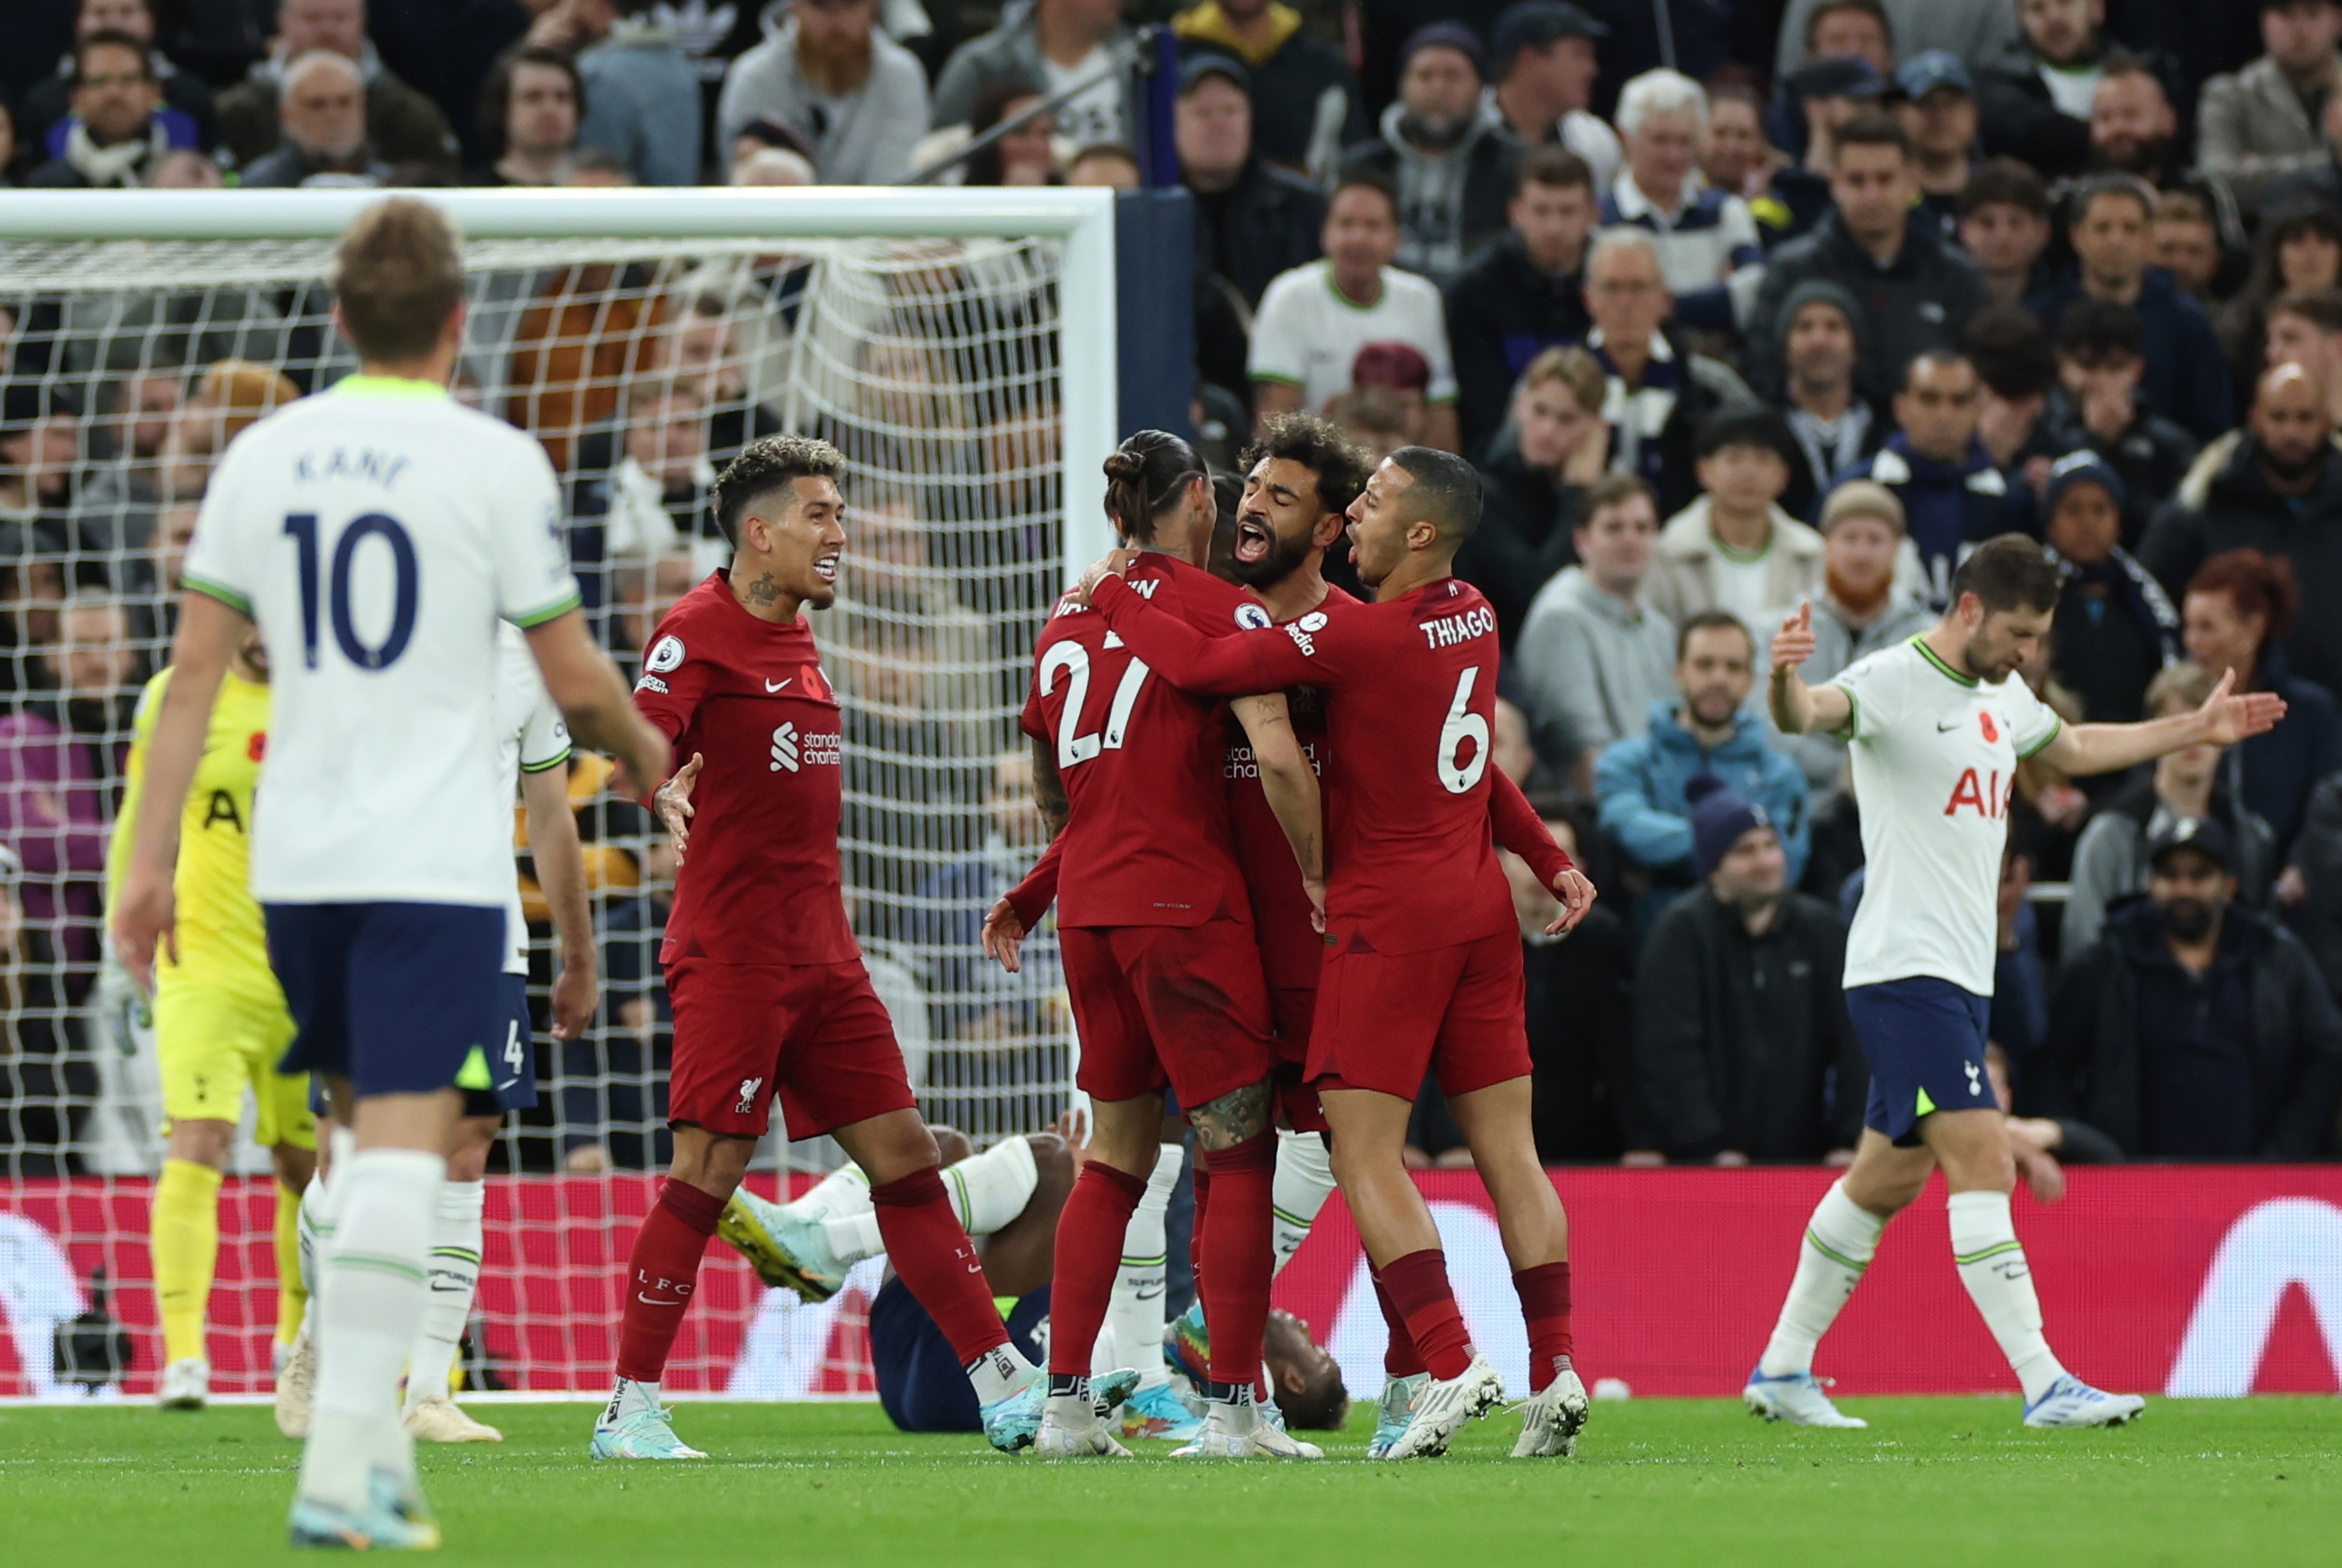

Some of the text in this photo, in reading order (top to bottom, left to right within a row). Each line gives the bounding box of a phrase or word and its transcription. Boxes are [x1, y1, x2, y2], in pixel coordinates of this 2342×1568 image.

[283, 512, 419, 671] 10
[1419, 606, 1494, 649] THIAGO
[1039, 629, 1150, 769] 27
[1438, 666, 1490, 794] 6
[735, 1104, 751, 1114] LFC
